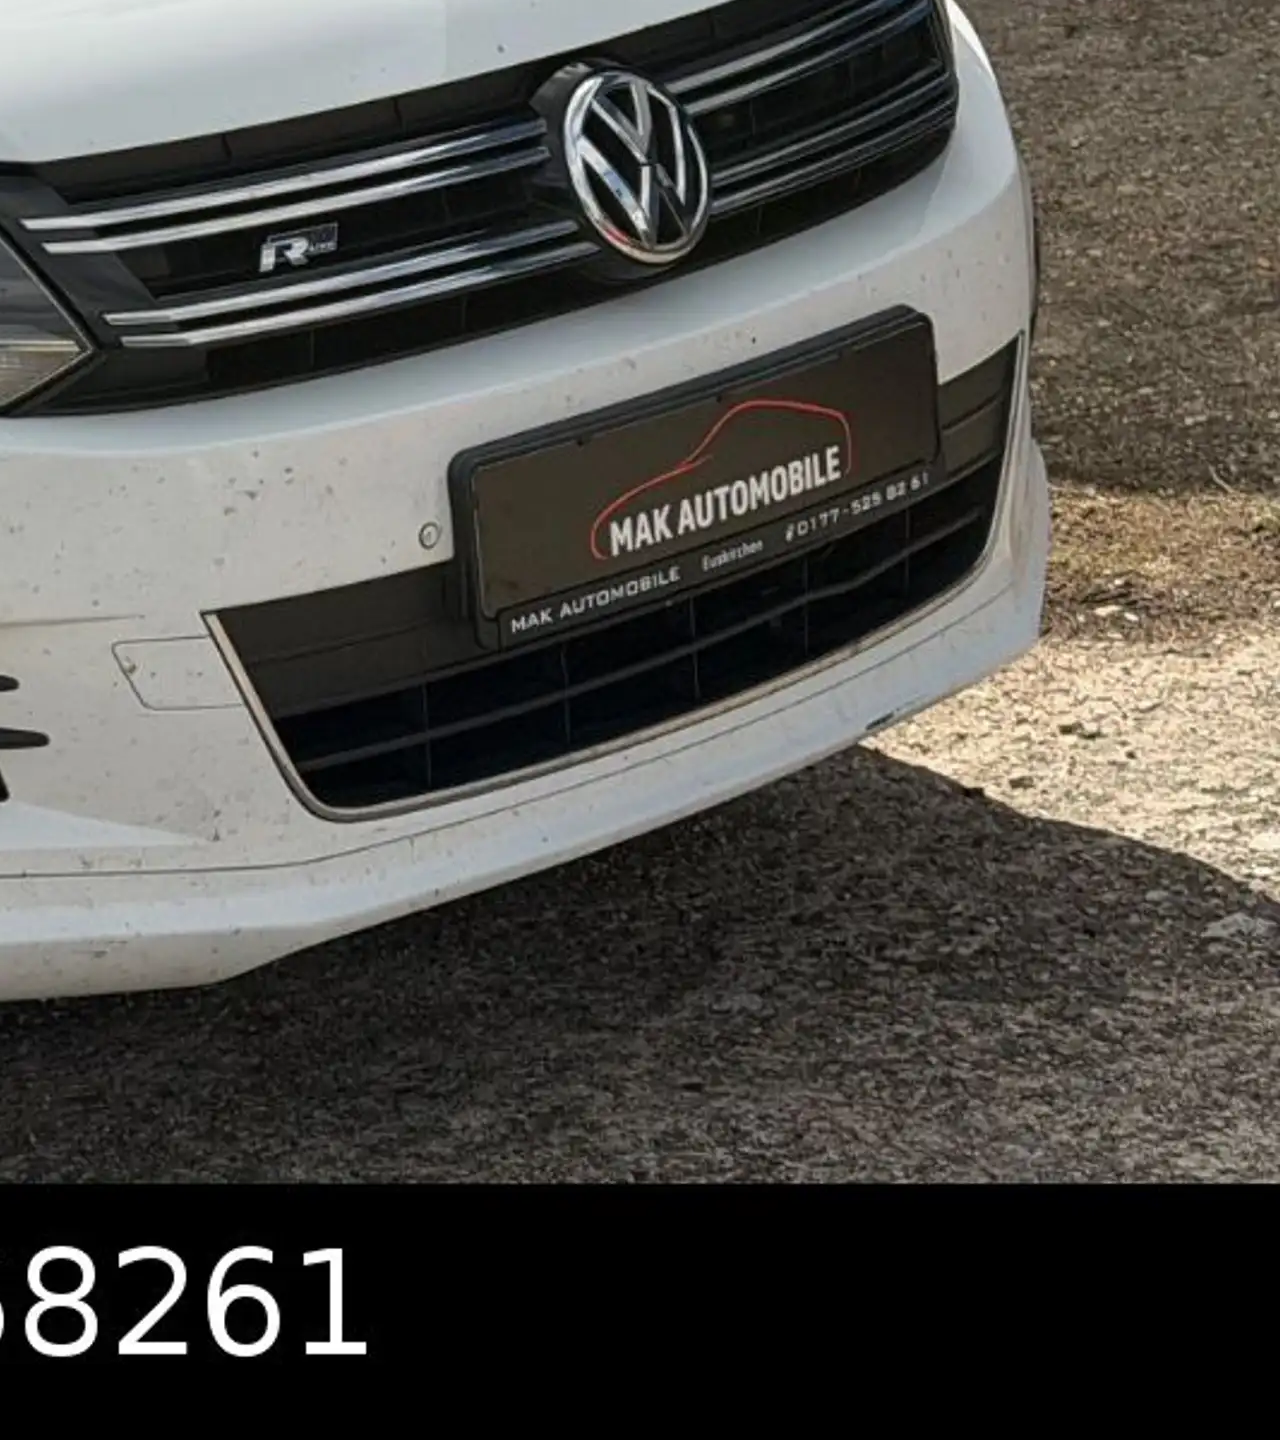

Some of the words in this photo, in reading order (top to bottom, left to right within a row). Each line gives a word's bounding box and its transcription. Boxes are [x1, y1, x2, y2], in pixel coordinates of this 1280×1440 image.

[610, 504, 672, 557] MAK
[678, 445, 841, 536] AUTOMOBILE
[511, 607, 553, 633] MAK
[559, 566, 680, 620] AUTOMOBILE
